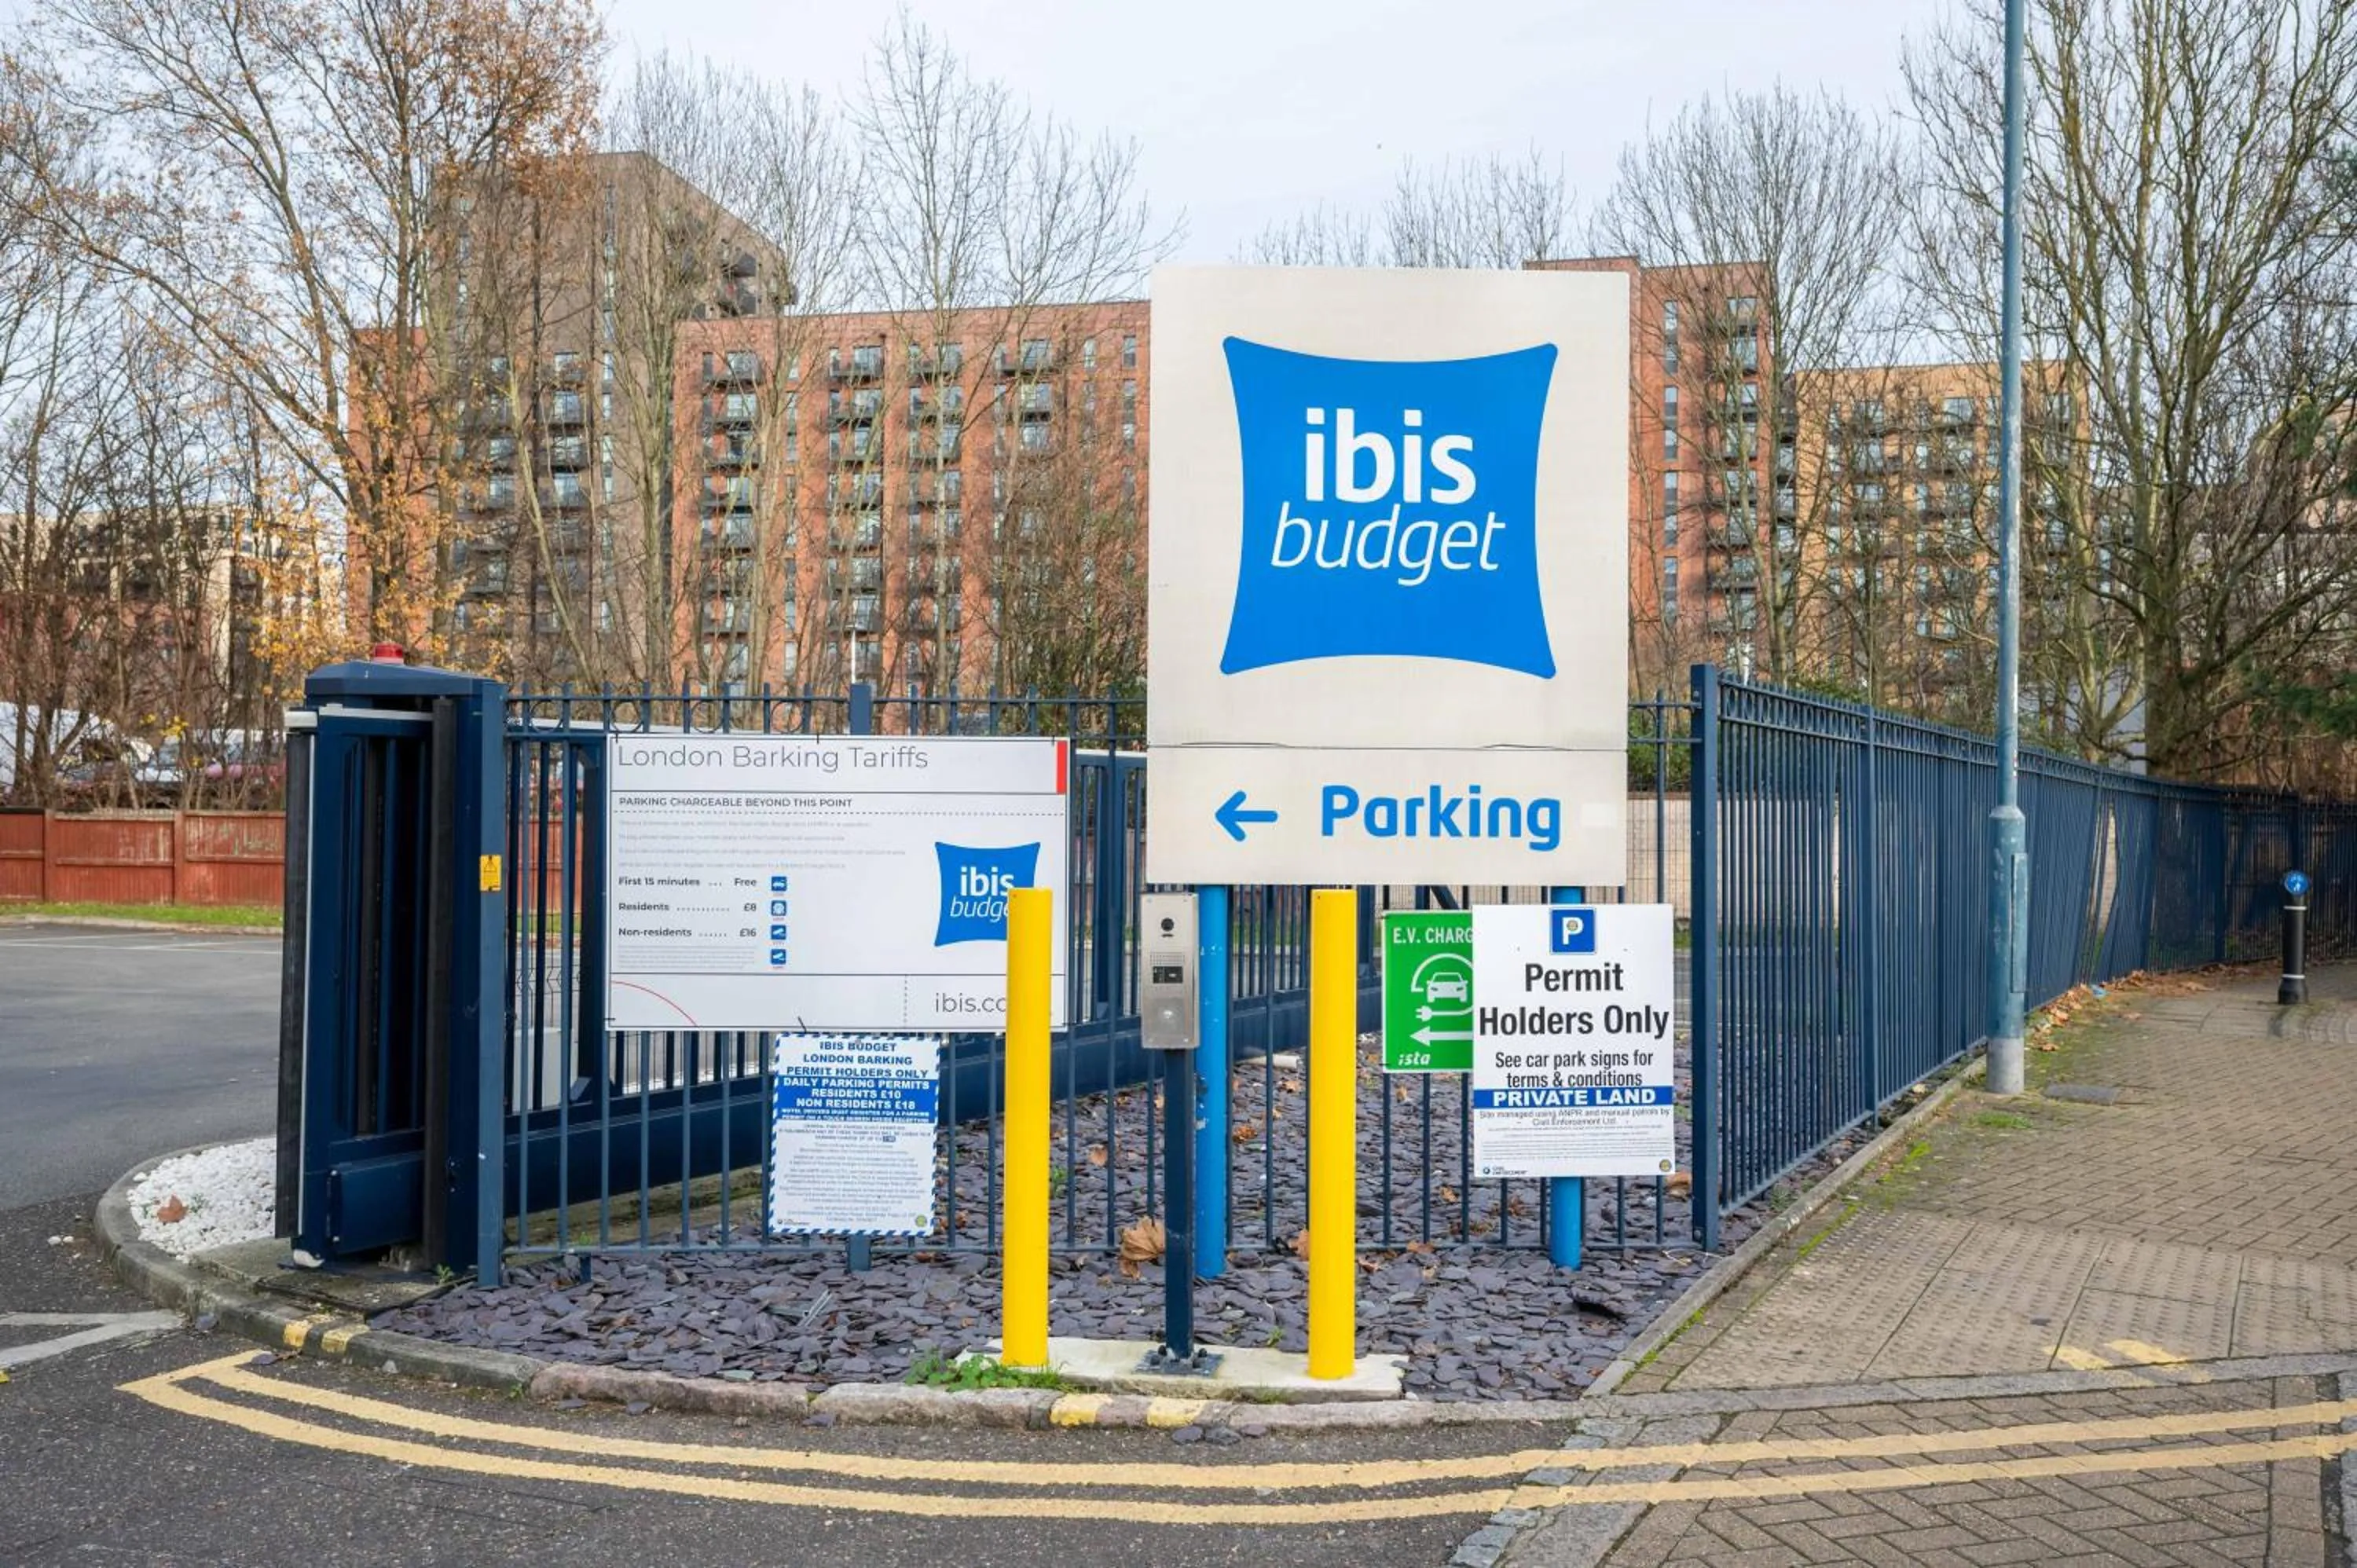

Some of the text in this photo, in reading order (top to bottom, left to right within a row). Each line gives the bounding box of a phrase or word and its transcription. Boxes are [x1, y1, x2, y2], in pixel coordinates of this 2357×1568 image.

[1305, 407, 1477, 505] ibis
[1270, 501, 1506, 587] budget
[618, 745, 929, 773] London Barking Tariffs
[619, 797, 852, 807] PARKING CHARGEABLE BEYOND THIS POINT
[1321, 784, 1561, 852] Parking
[618, 877, 642, 886] First
[657, 877, 701, 886] minutes
[734, 878, 757, 887] Free
[960, 866, 1016, 896] ibis
[618, 903, 757, 912] Residents £8
[950, 896, 1009, 923] budg
[618, 927, 757, 937] Non-residents £16
[1393, 927, 1473, 943] E.V. CHARG
[1562, 917, 1584, 945] P
[1525, 962, 1624, 992] Permit
[935, 992, 1006, 1013] ibis.co
[1479, 1005, 1670, 1039] Holders Only
[819, 1041, 897, 1052] IBIS BUDGET
[804, 1053, 913, 1065] LONDON BARKING
[1495, 1050, 1654, 1070] See car park signs for
[786, 1066, 929, 1079] PERMIT HOLDERS ONLY
[1507, 1070, 1643, 1088] terms & conditions
[783, 1077, 929, 1090] DAILY PARKING PERMITS
[812, 1088, 901, 1099] RESIDENTS £10
[1493, 1088, 1656, 1107] PRIVATE LAND
[796, 1097, 915, 1110] NON RESIDENTS £18
